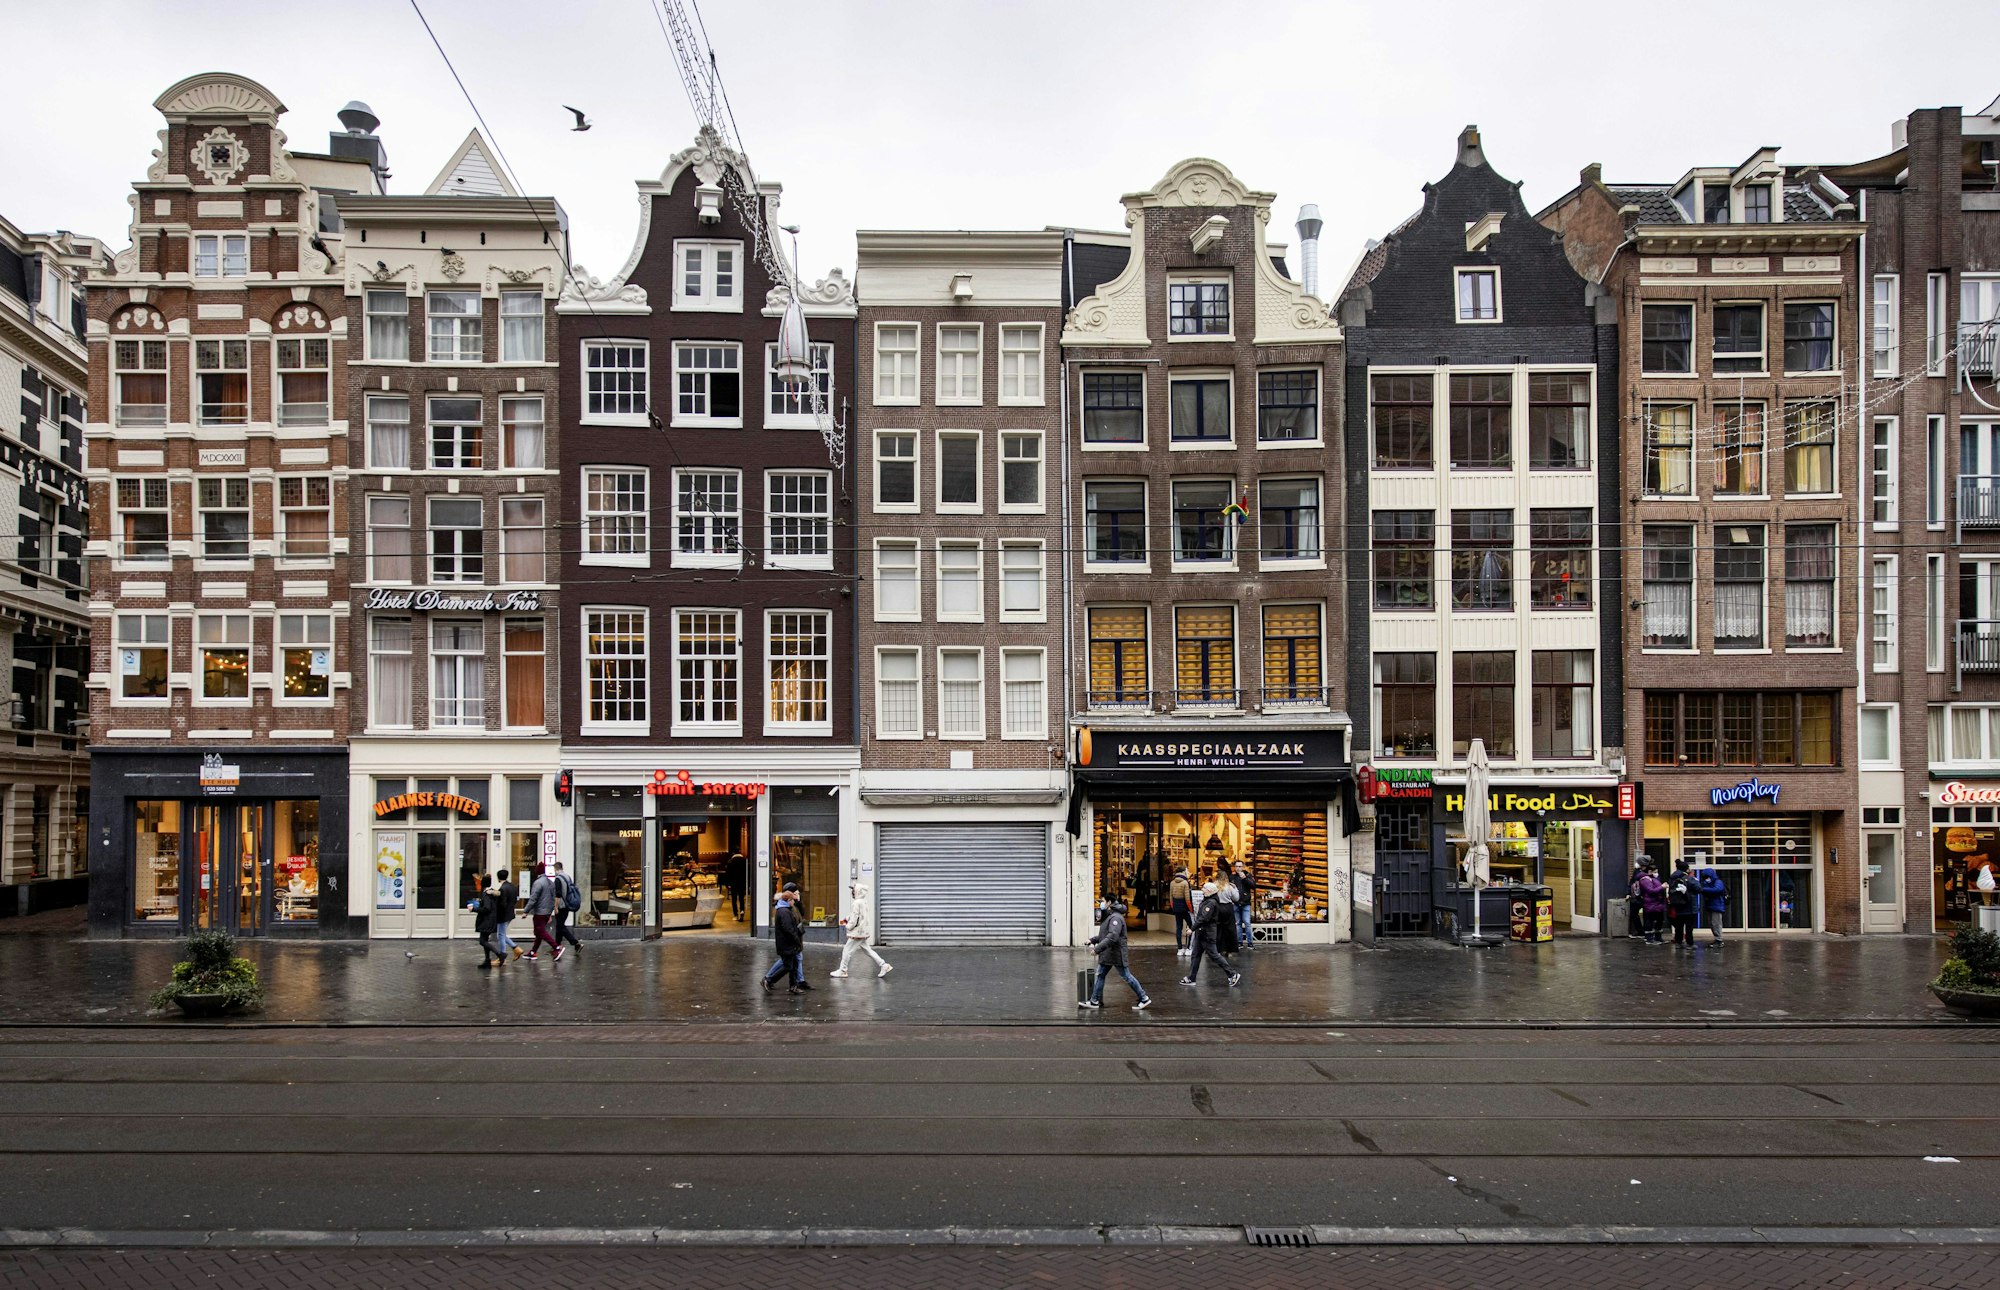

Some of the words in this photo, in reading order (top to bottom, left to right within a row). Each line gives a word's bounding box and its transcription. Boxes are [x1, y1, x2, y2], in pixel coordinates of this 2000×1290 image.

[364, 588, 415, 610] Hotel
[415, 589, 495, 611] Damrak
[496, 590, 539, 611] Inn
[1118, 743, 1304, 756] KAASSPECIAALZAAK
[1177, 758, 1207, 766] HENRI
[1211, 758, 1245, 766] WILLIG
[647, 769, 695, 795] simit
[1376, 768, 1433, 782] INDIAN
[1390, 788, 1433, 798] GANDHI
[373, 792, 434, 816] VLAAMSE
[436, 792, 481, 817] FRITES
[1505, 793, 1556, 811] Food
[619, 830, 642, 838] PASTRY
